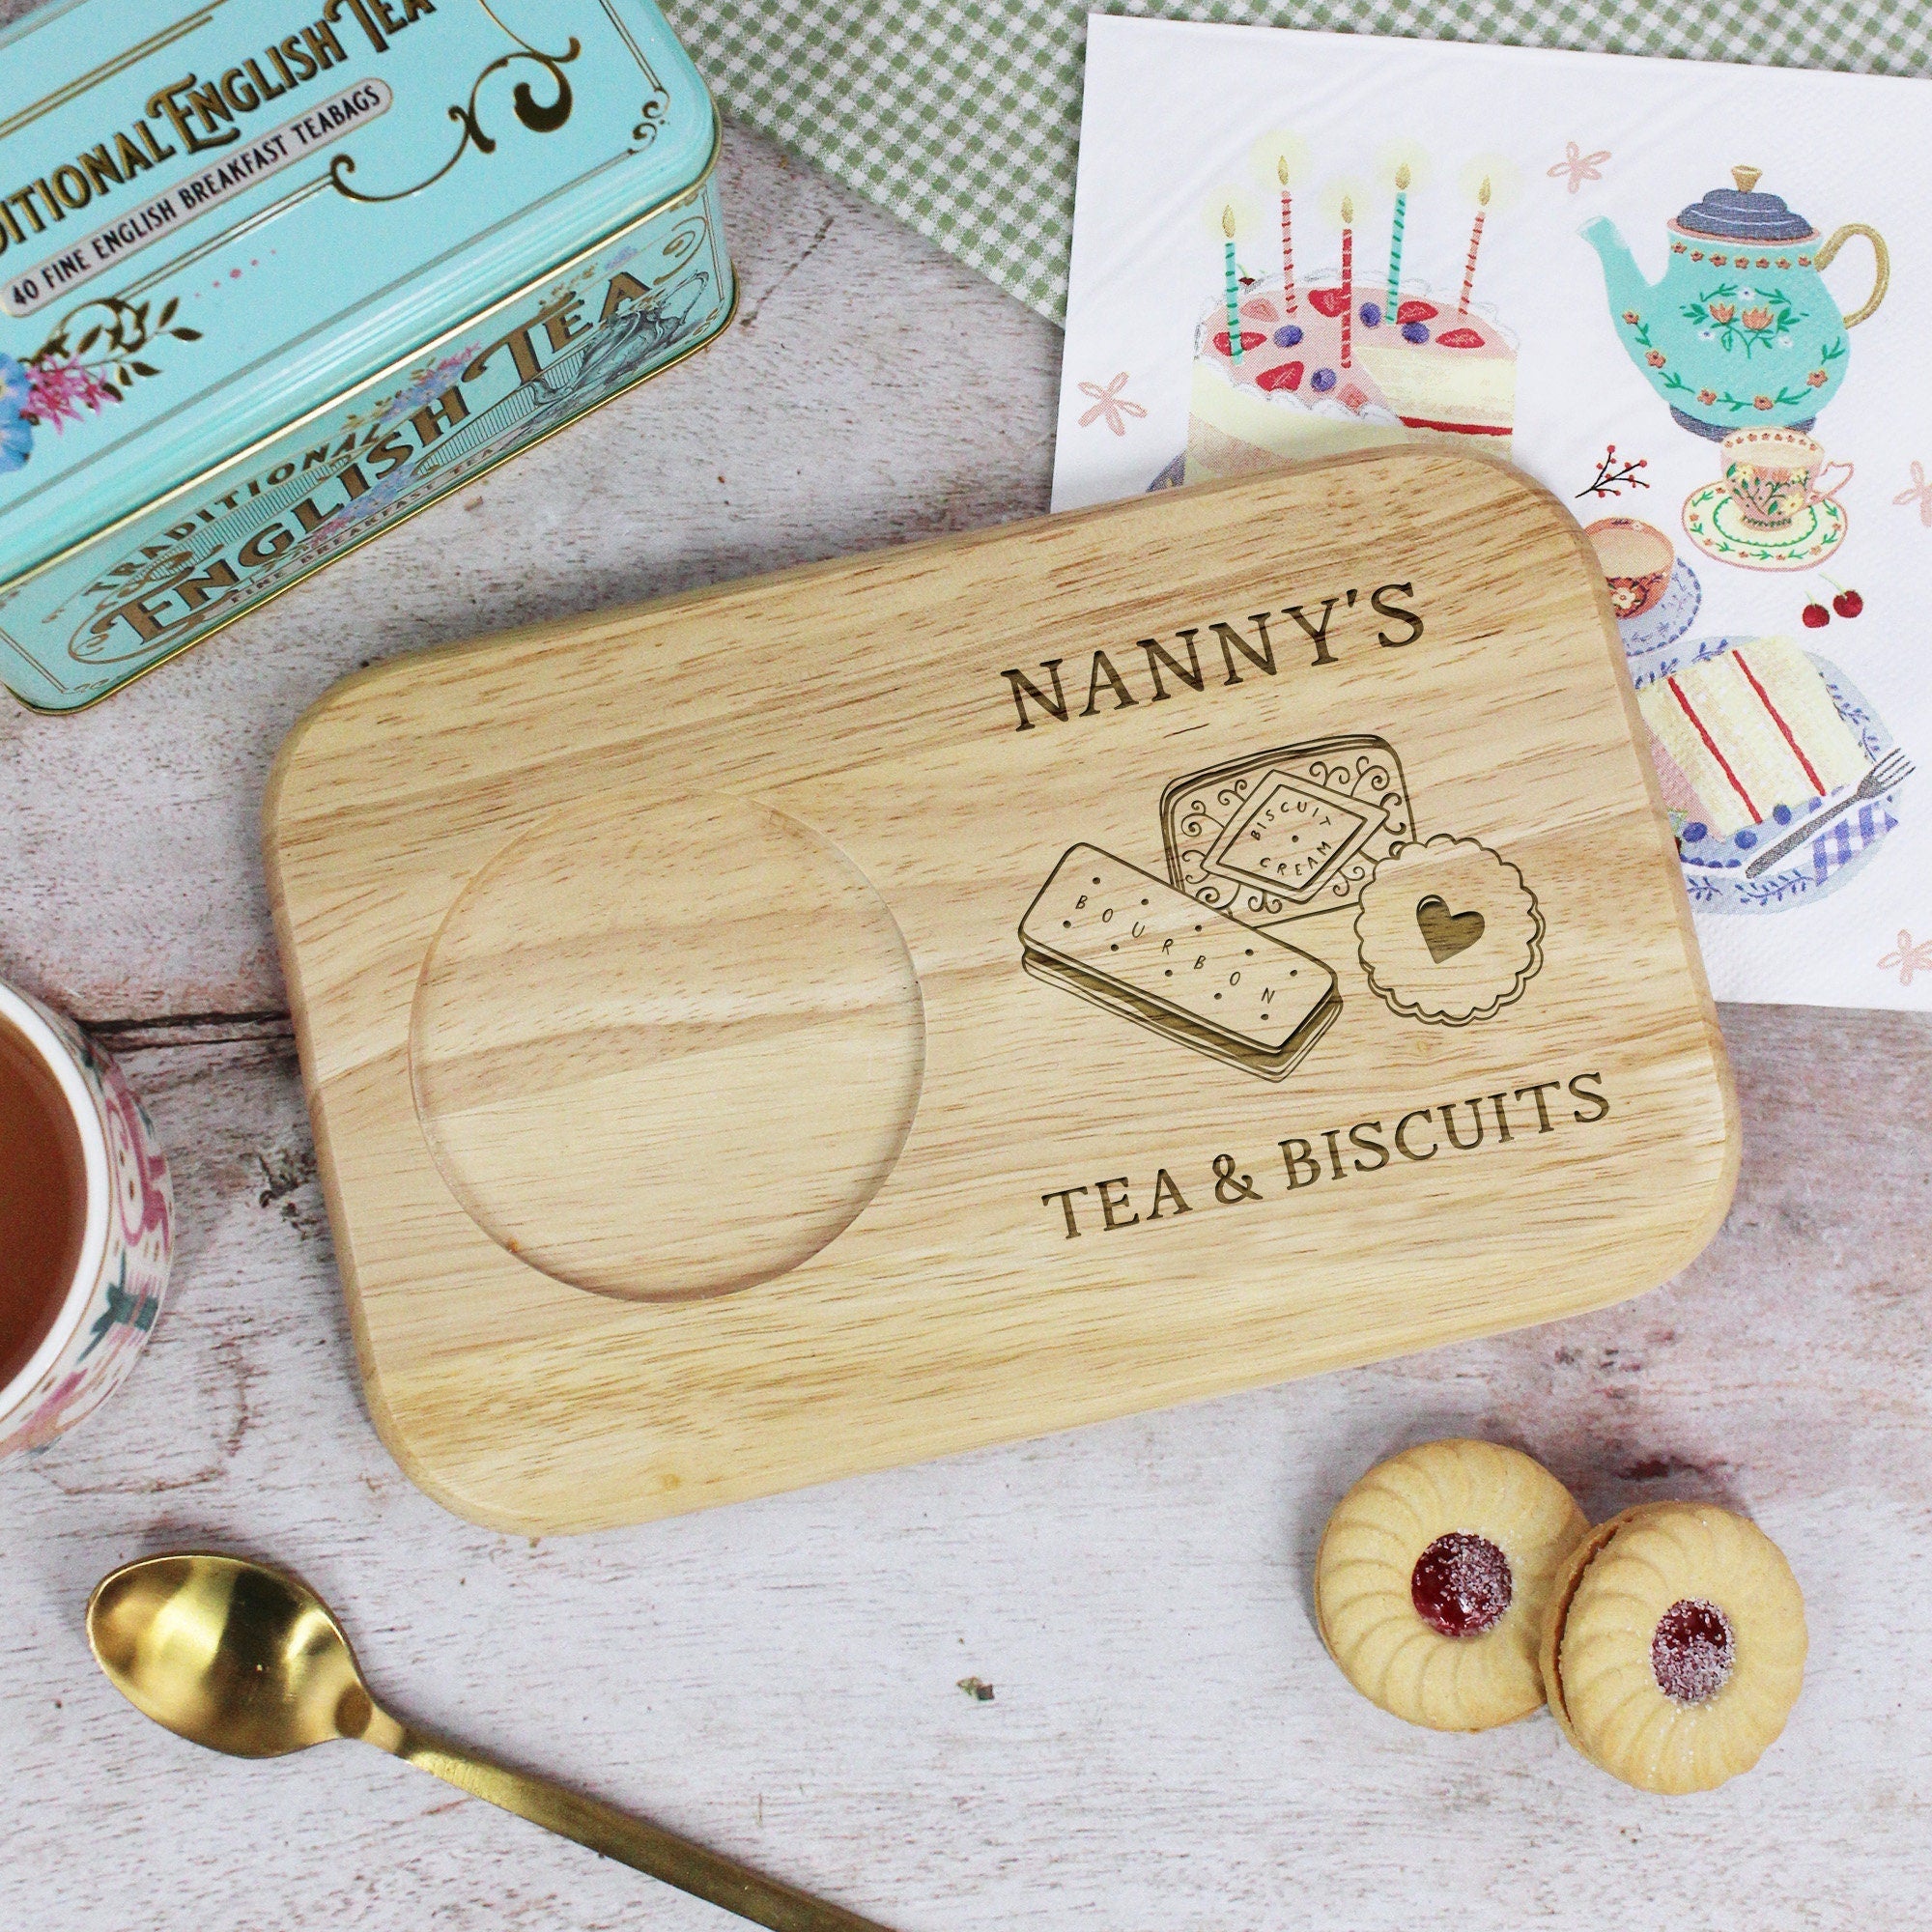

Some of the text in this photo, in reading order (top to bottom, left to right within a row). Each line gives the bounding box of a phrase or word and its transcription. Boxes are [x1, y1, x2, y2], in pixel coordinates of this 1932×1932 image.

[0, 120, 177, 256] ITIONAL
[146, 19, 348, 155] ENGLISH
[13, 83, 381, 304] 40 FINE ENGLISH BREAKFAST TEABAGS
[83, 422, 381, 596] TRADITIONAL
[90, 271, 652, 645] ENGLISH TEA
[1001, 581, 1427, 732] NANNY'S
[1250, 801, 1331, 840] BISCUIT
[1259, 840, 1331, 875] CREAM
[1074, 895, 1277, 1006] BOURBON
[1041, 1071, 1611, 1240] TEA & BISCUITS
